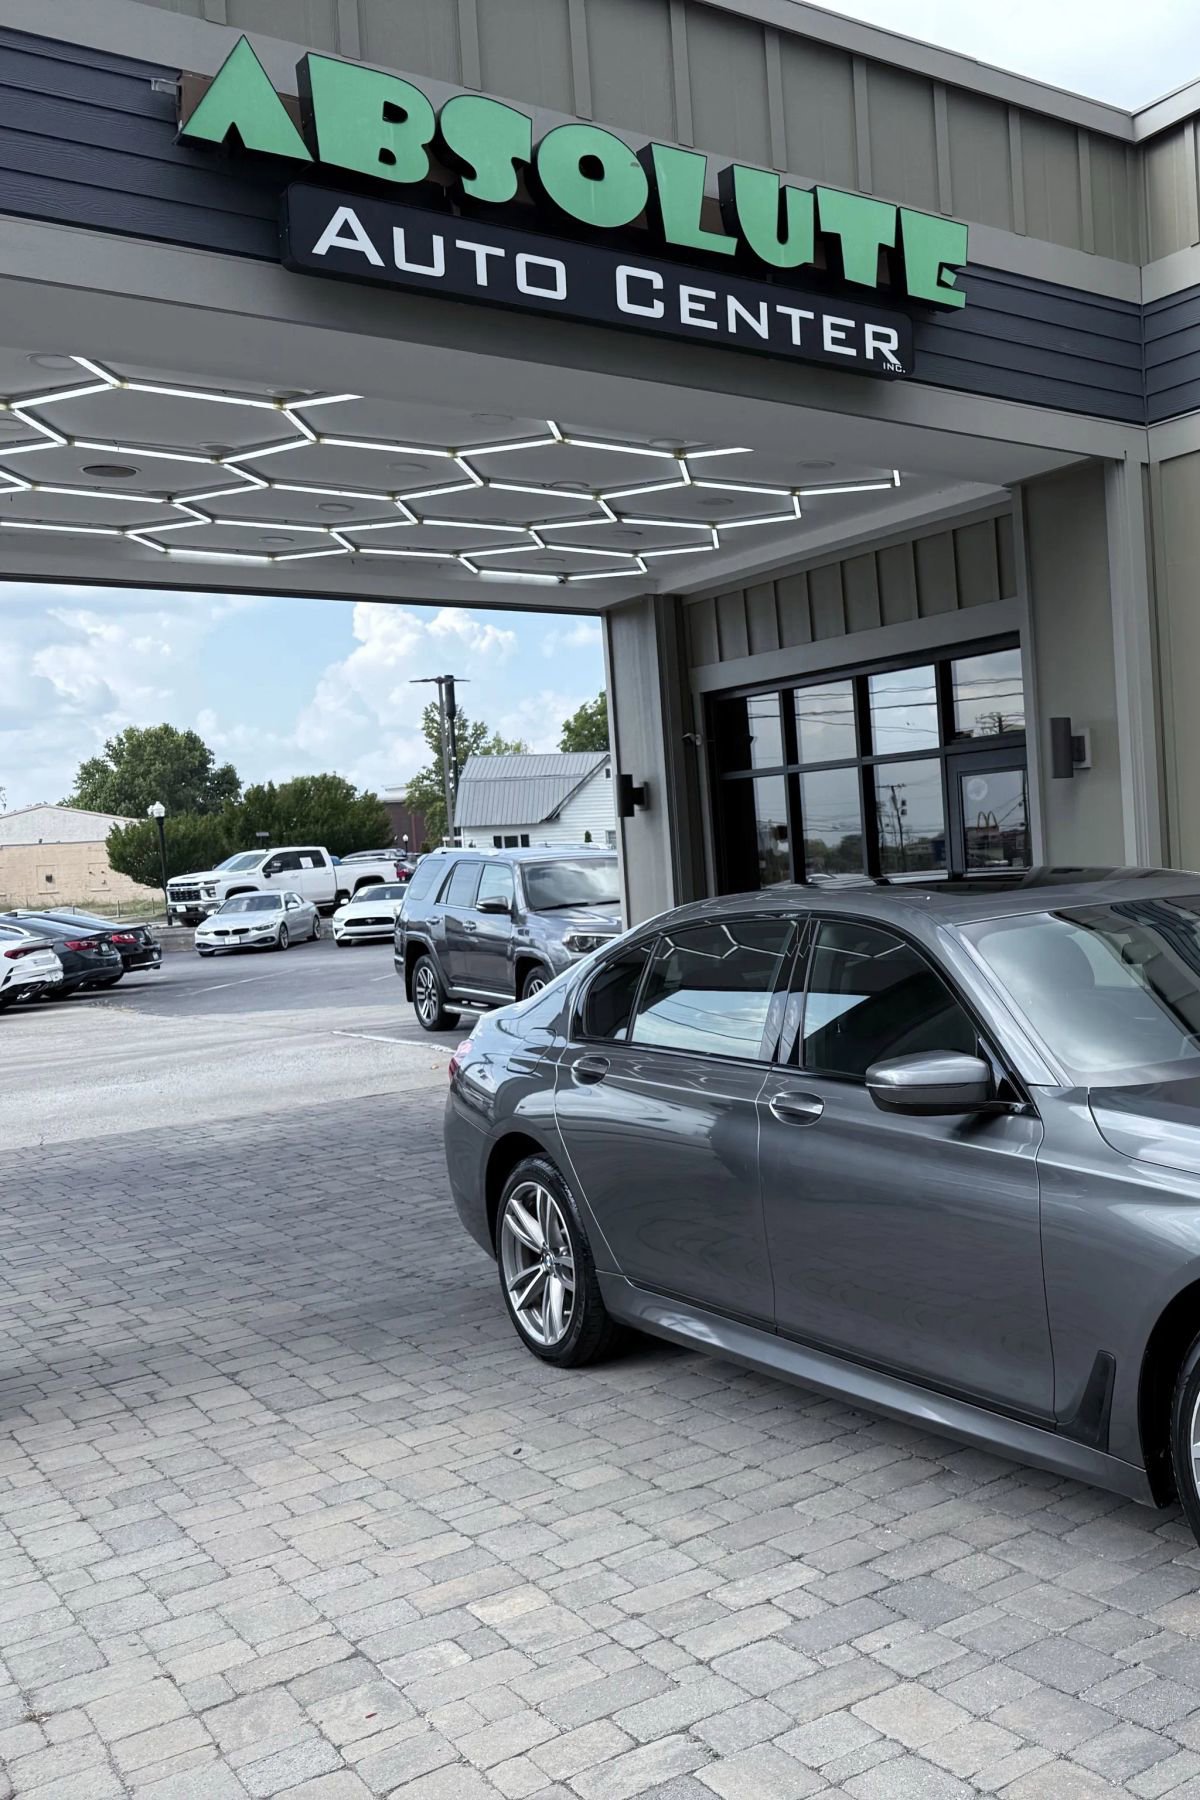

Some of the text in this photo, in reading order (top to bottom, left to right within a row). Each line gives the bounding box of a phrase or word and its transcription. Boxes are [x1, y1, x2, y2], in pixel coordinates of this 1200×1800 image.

[180, 34, 968, 310] ABSOLUTE
[311, 206, 901, 365] AUTO CENTER
[882, 361, 906, 373] INC.
